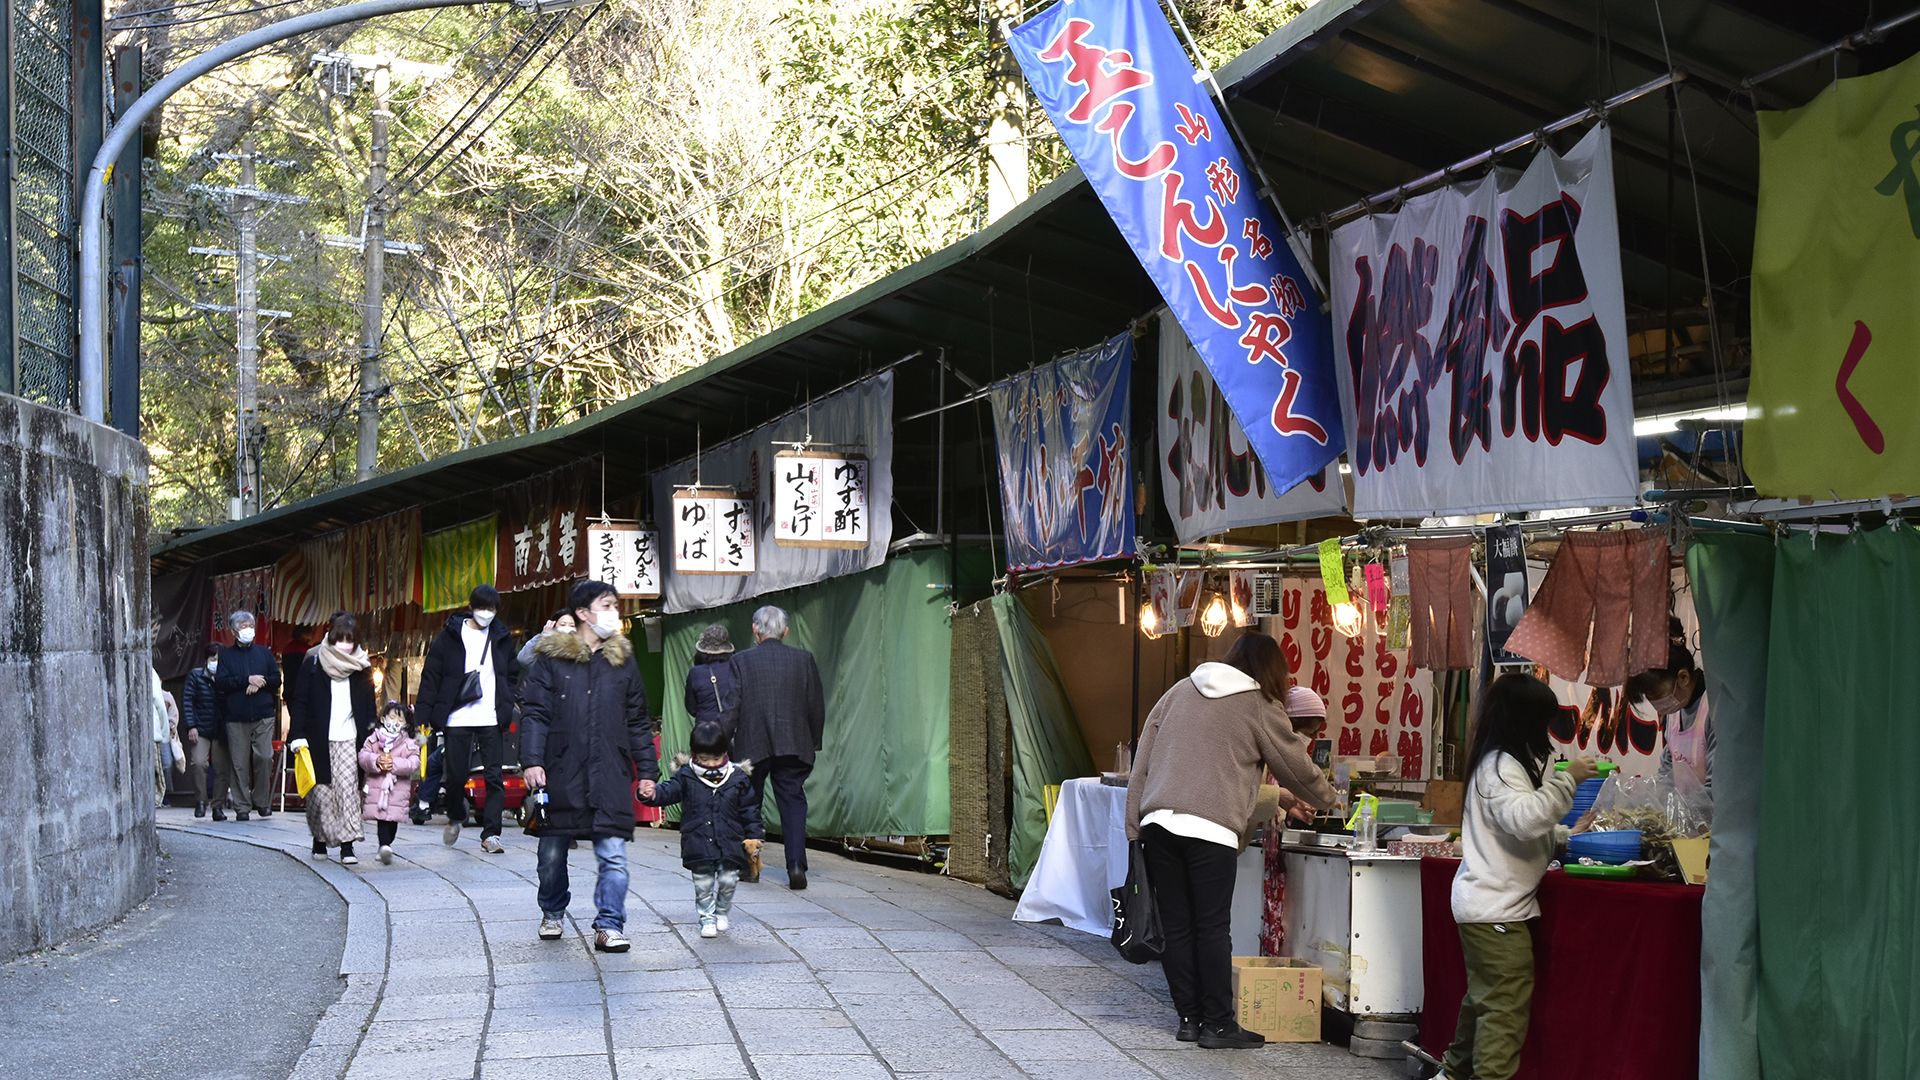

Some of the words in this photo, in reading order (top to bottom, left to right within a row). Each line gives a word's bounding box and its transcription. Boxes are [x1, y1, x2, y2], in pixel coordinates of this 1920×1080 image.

[1175, 102, 1306, 318] 山形名物
[682, 501, 709, 560] ゆば
[786, 463, 817, 537] 山くらげ
[834, 461, 862, 535] ゆず酢
[634, 532, 654, 589] ぜんまい
[723, 502, 751, 566] ずいき
